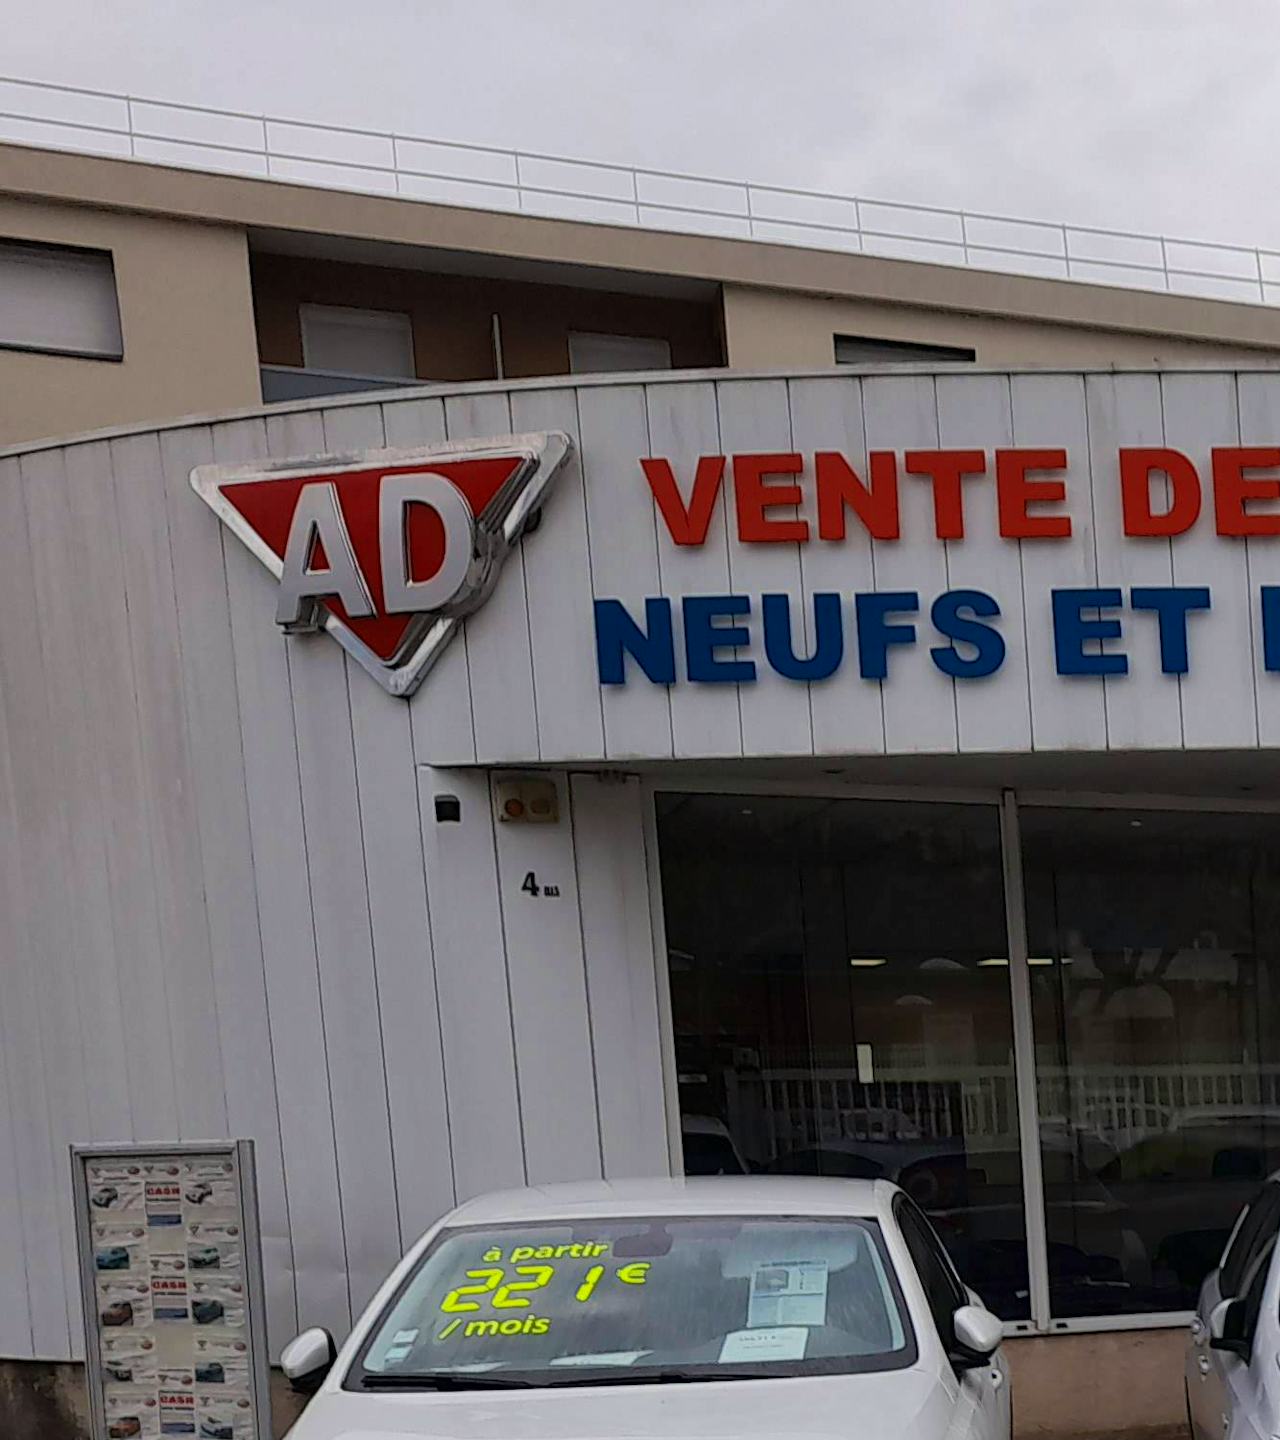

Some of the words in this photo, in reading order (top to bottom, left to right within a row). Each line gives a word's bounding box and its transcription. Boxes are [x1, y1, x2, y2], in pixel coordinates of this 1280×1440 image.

[640, 447, 1073, 547] VENTE
[275, 471, 480, 628] AD
[593, 588, 1007, 686] NEUFS
[1050, 586, 1211, 676] ET
[521, 871, 540, 897] 4
[482, 1246, 504, 1263] à
[509, 1240, 609, 1264] partir
[463, 1314, 552, 1338] mois
